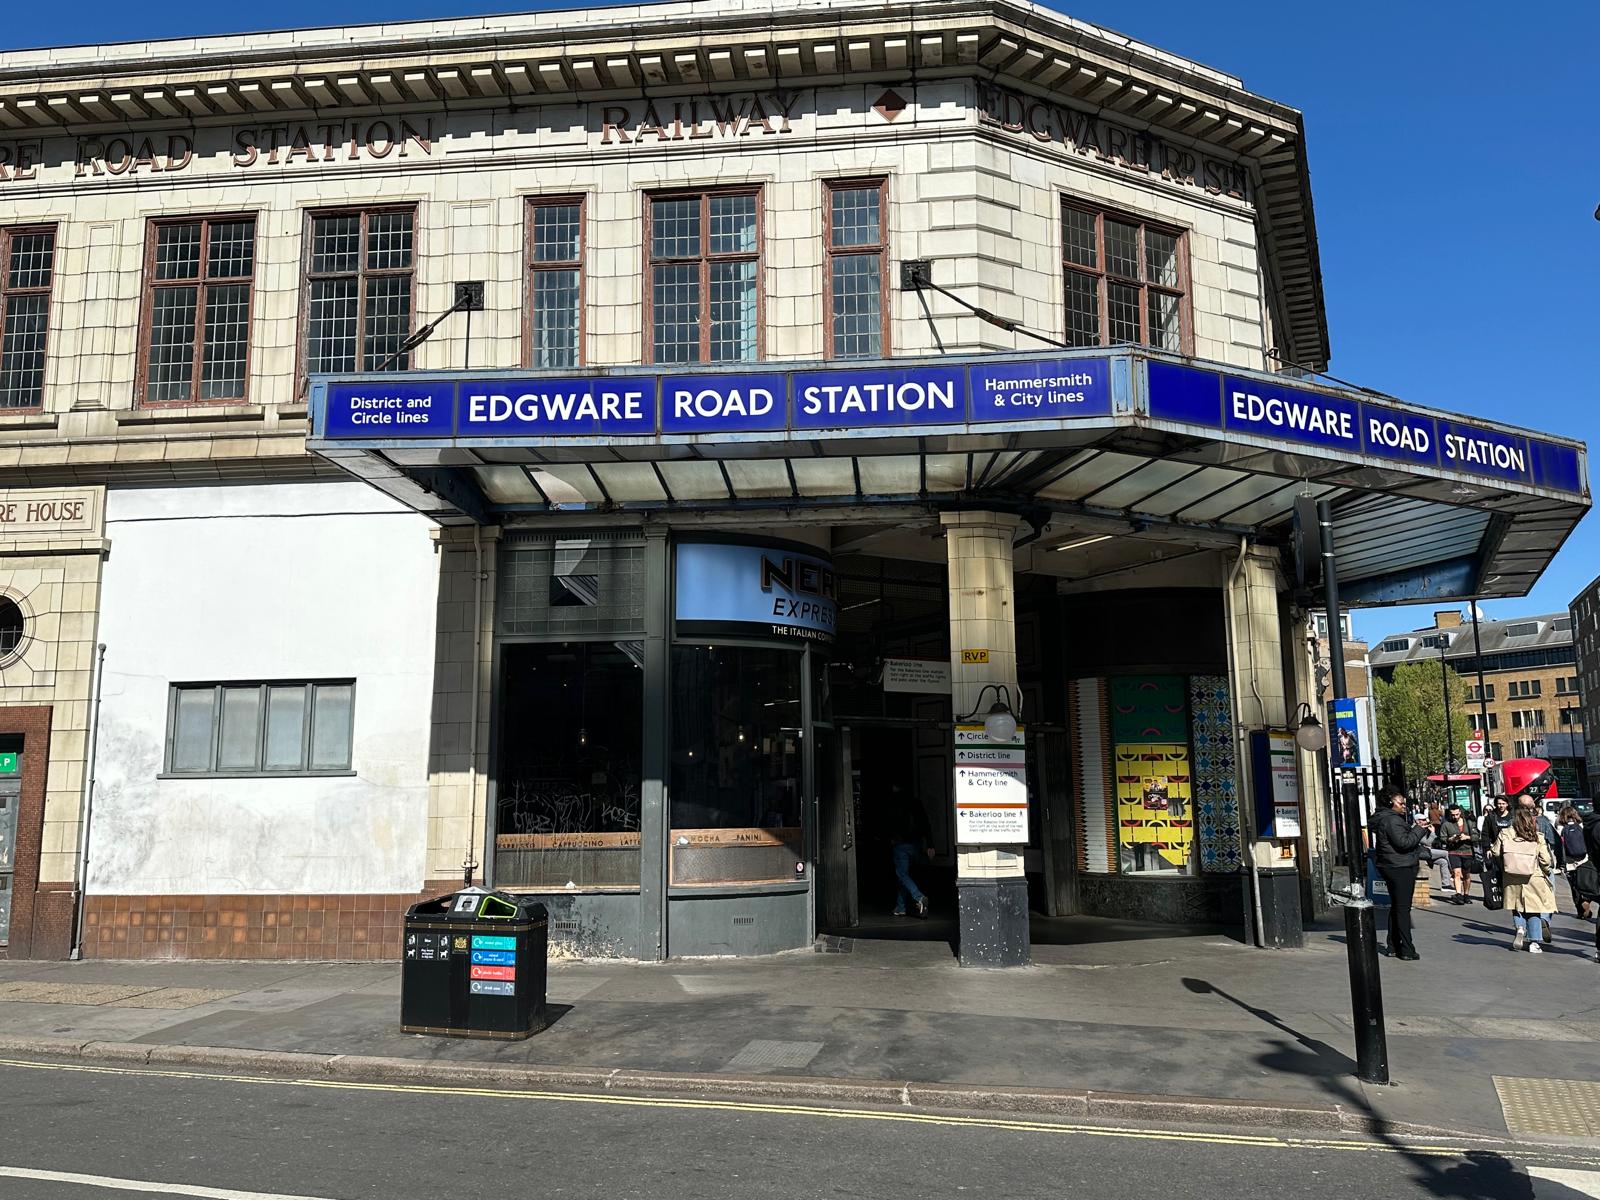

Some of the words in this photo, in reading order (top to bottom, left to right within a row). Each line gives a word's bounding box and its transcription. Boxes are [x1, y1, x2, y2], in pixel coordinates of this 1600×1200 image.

[75, 135, 193, 177] ROAD
[233, 118, 434, 167] STATION
[600, 94, 800, 144] RAILWAY
[977, 86, 1149, 173] EDGWARE
[985, 373, 1092, 391] Hammersmith
[350, 397, 402, 409] District
[406, 395, 431, 408] and
[469, 392, 643, 422] EDGWARE
[674, 388, 773, 418] ROAD
[803, 380, 954, 415] STATION
[994, 394, 1005, 406] &
[1011, 392, 1042, 407] City
[1048, 391, 1084, 404] lines
[351, 412, 392, 424] Circle
[396, 411, 428, 423] lines
[1232, 391, 1353, 439] EDGWARE
[1370, 418, 1429, 453] ROAD
[1445, 434, 1525, 472] STATION
[26, 502, 84, 522] HOUSE
[772, 625, 788, 635] THE
[790, 628, 817, 639] ITALIAN
[964, 651, 986, 661] RVP
[967, 732, 989, 740] Circle
[976, 779, 992, 787] City
[553, 840, 604, 848] CAPPUCCINO
